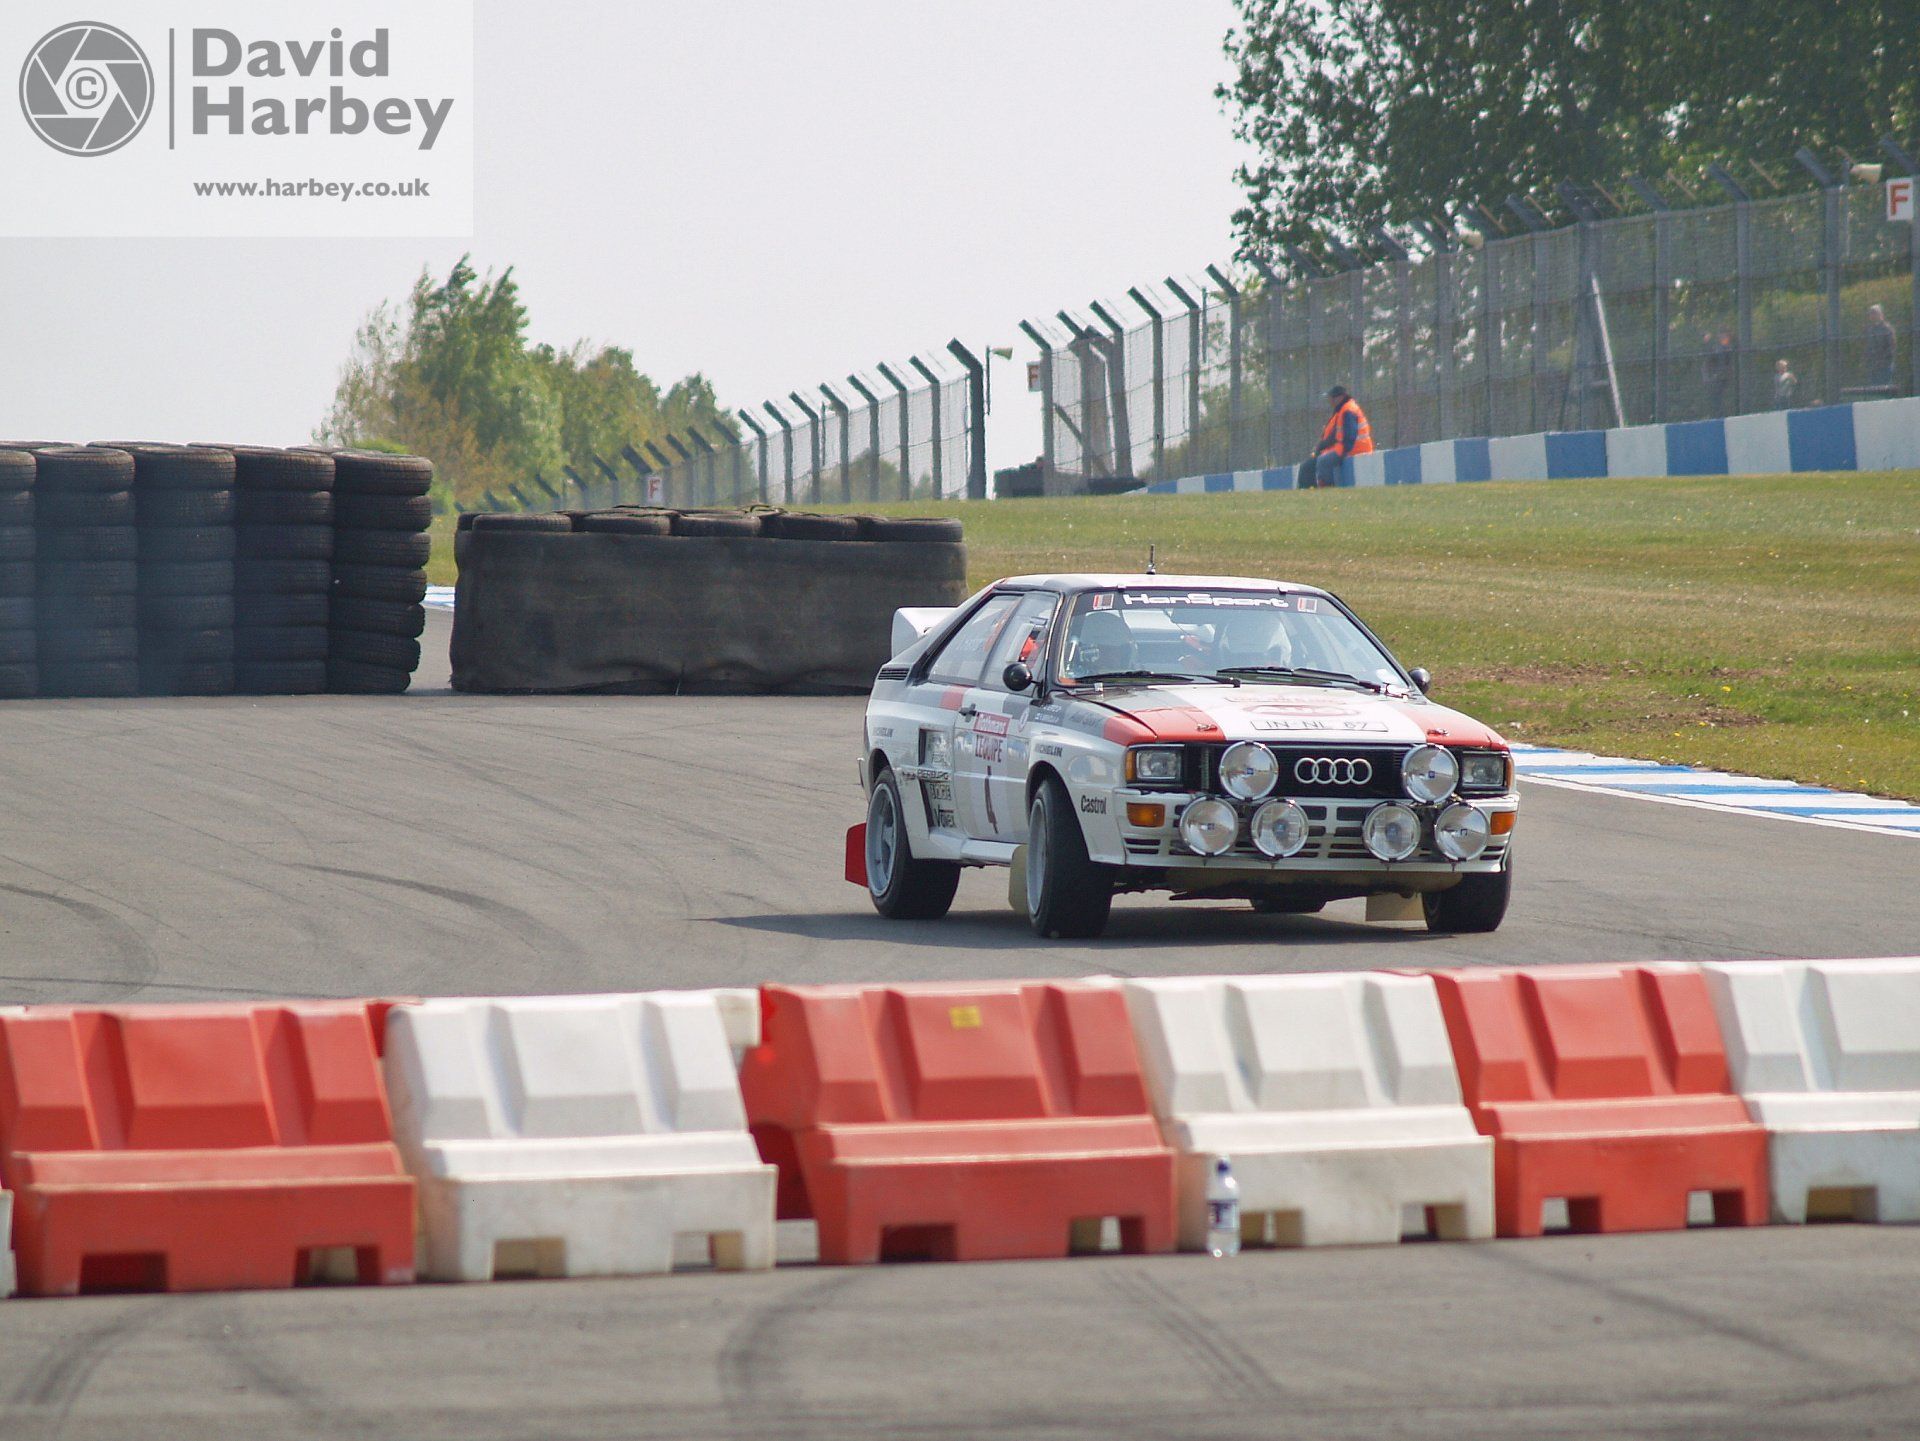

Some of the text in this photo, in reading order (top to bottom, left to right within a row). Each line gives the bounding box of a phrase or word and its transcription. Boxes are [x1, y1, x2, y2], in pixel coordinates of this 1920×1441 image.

[1890, 183, 1910, 217] F
[649, 479, 661, 499] F
[1080, 794, 1107, 815] Castrol
